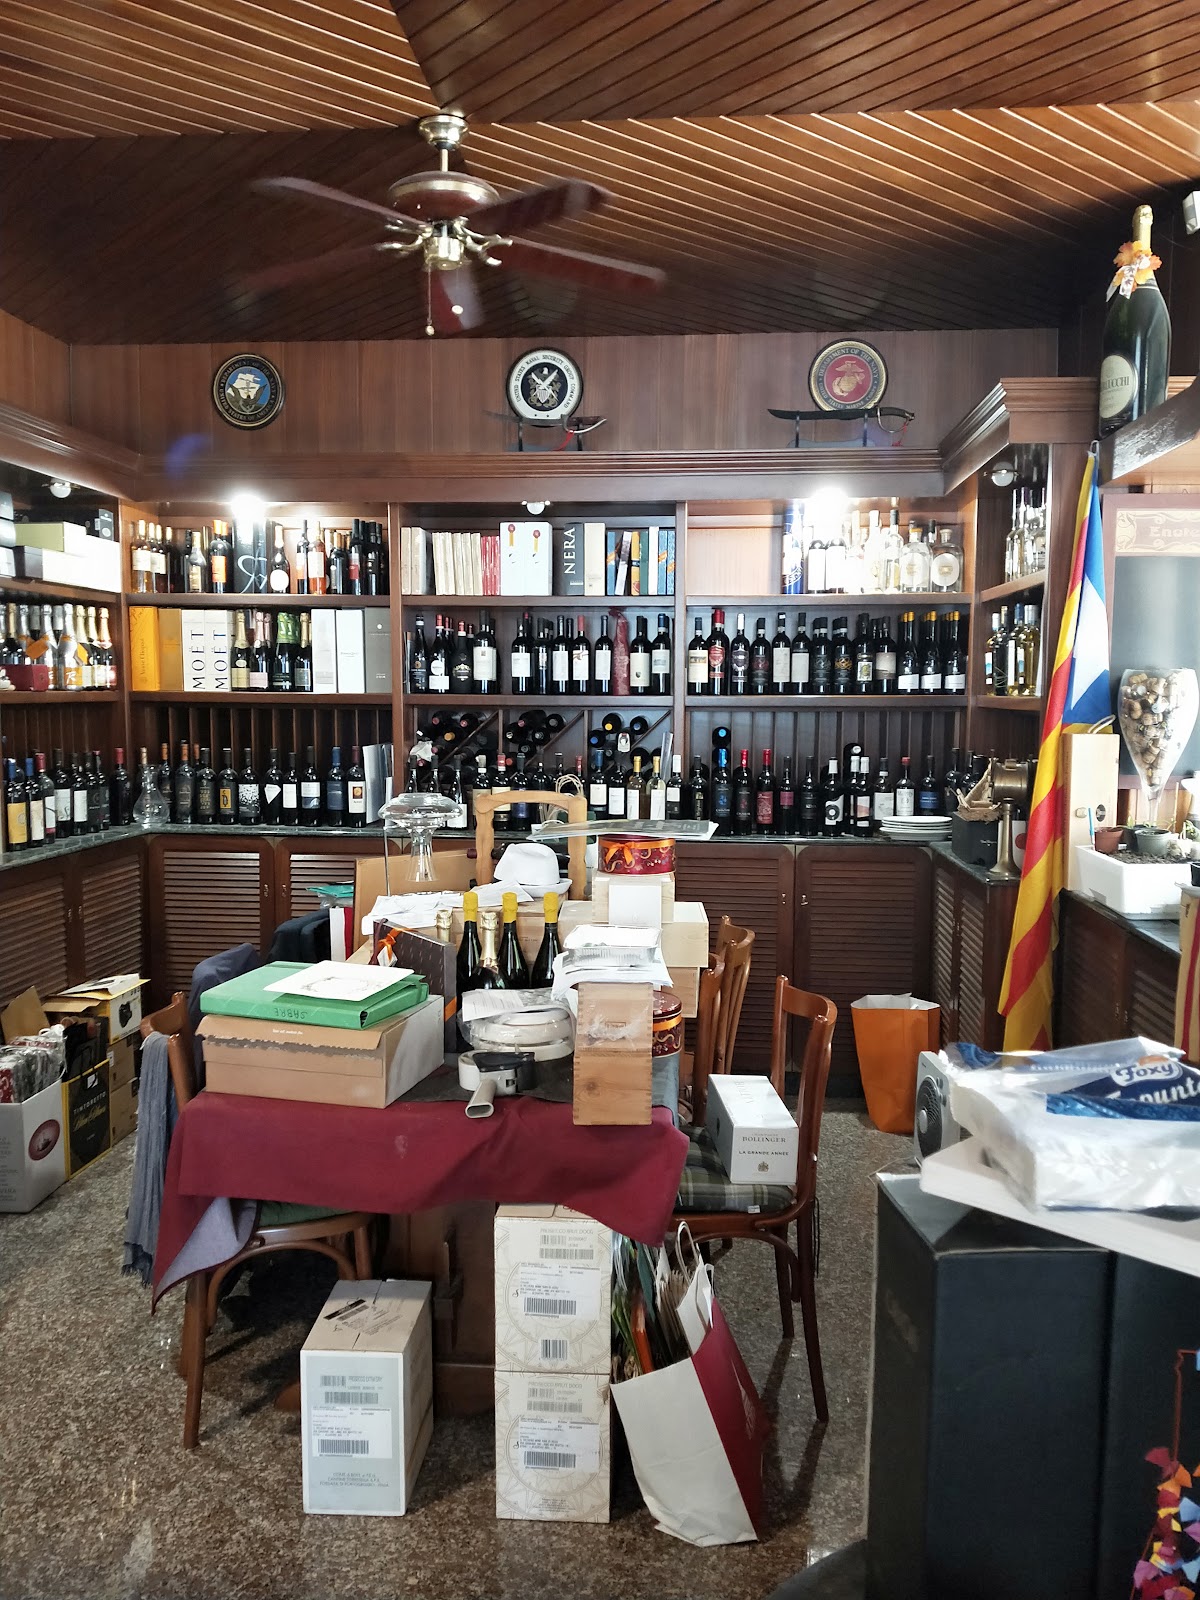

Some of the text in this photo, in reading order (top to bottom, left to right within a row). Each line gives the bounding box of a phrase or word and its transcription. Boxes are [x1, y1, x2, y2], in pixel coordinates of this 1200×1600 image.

[515, 366, 526, 382] STATES
[542, 354, 564, 366] SECURITY
[819, 348, 849, 377] DEPARTMENT
[860, 351, 872, 363] THE
[871, 362, 879, 378] NAVY
[563, 526, 576, 575] NERA
[189, 629, 206, 690] MOËT
[211, 629, 229, 690] MOËT
[274, 1007, 308, 1019] SABRE
[1115, 1063, 1174, 1082] Foxy
